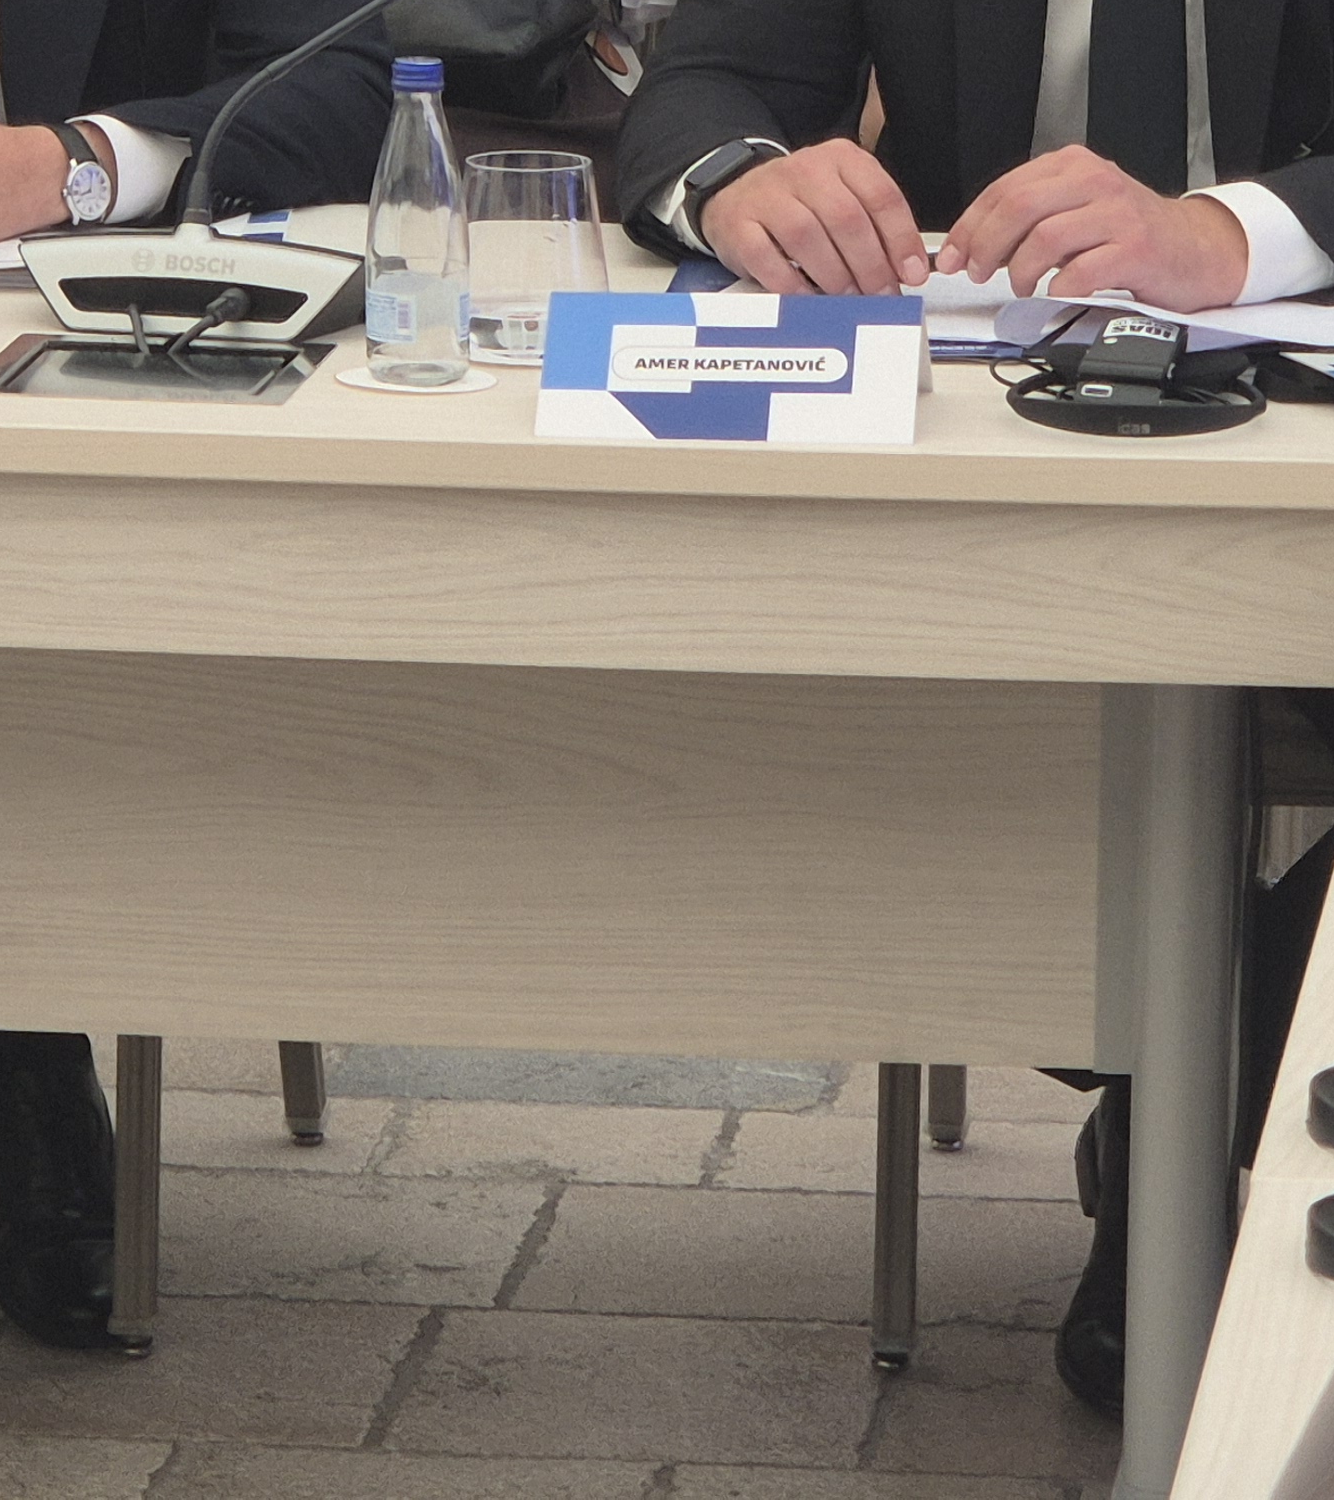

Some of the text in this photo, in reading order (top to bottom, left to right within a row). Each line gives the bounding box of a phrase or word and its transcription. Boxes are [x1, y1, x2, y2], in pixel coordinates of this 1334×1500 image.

[165, 254, 236, 275] BOSCH
[634, 356, 827, 372] AMER KAPETANOVIĆ
